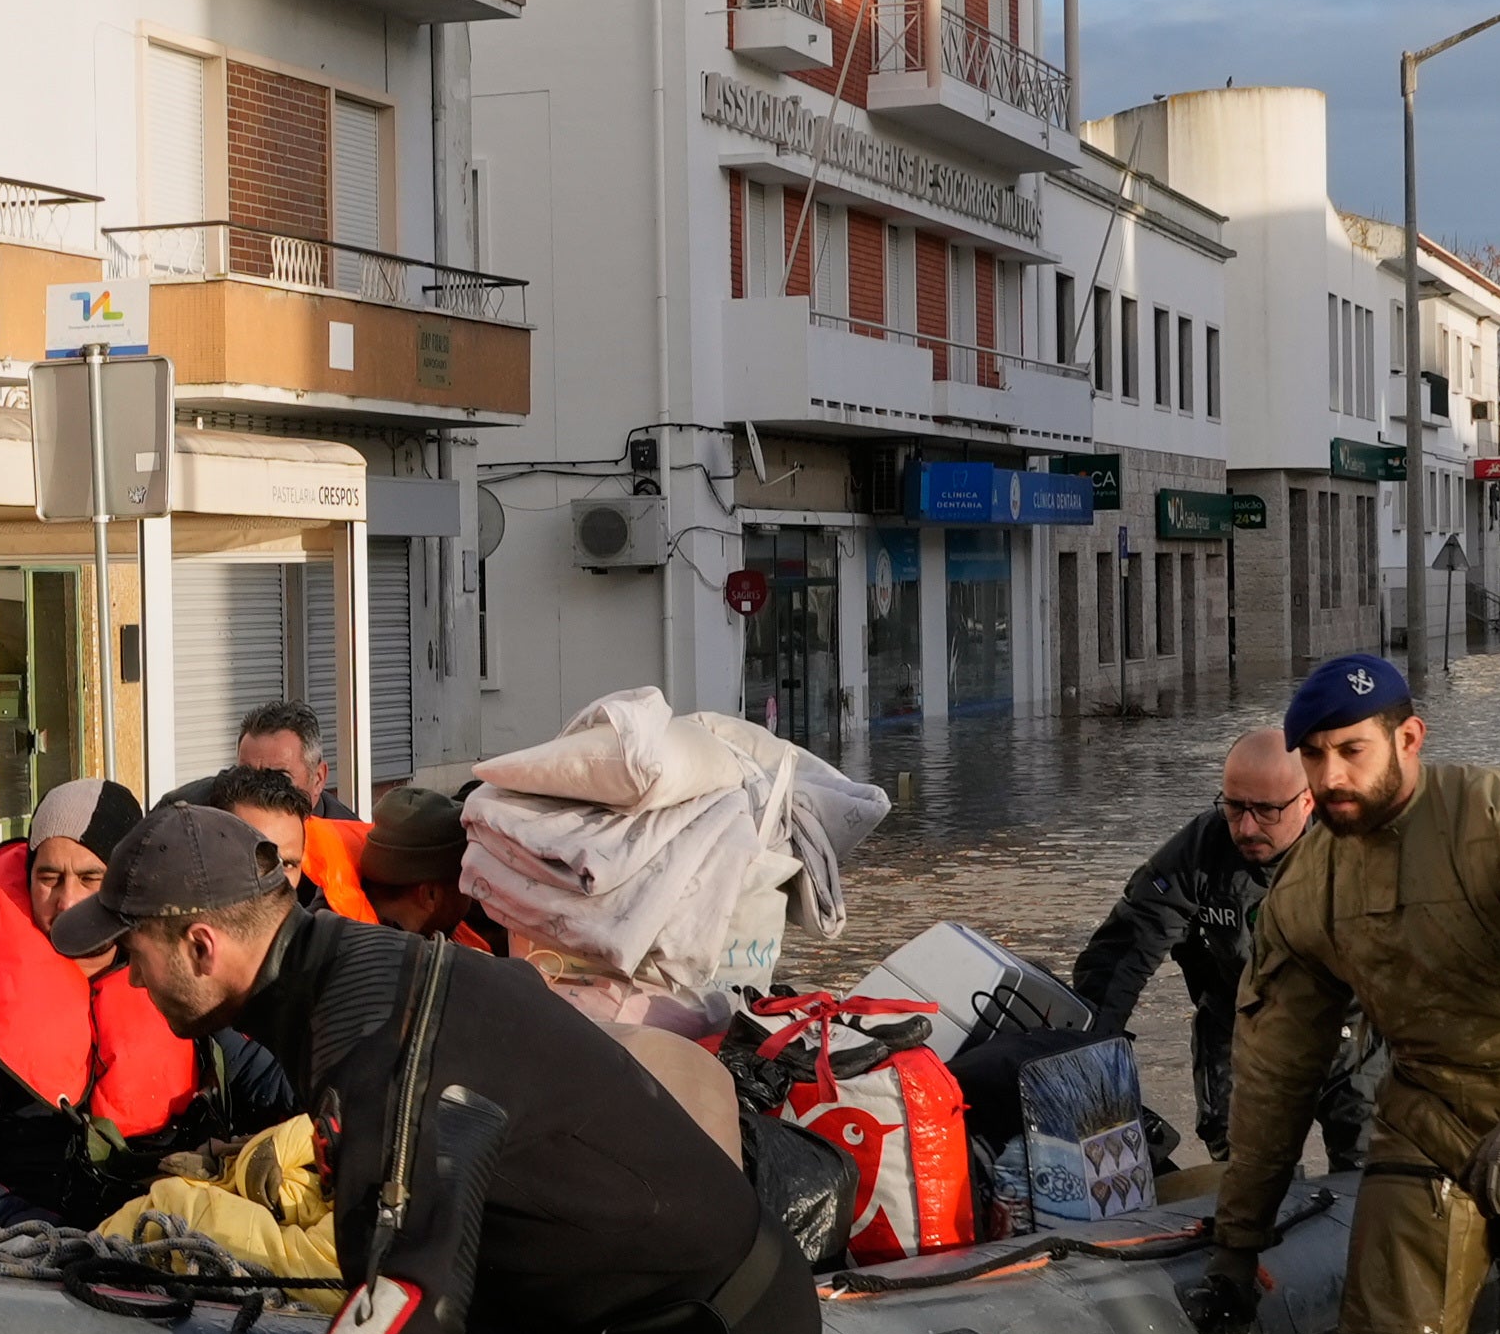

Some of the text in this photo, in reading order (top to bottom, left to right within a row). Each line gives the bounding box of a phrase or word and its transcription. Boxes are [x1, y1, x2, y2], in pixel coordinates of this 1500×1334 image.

[708, 72, 815, 153] ASSOCIAÇÃO
[917, 157, 935, 194] DE
[937, 167, 999, 222] SOCORROS
[1091, 470, 1117, 488] CA
[272, 485, 360, 507] PASTELARIA CRESPO'S
[941, 491, 979, 499] CLÍNICA
[1033, 488, 1083, 509] CLÍNICA DENTÁRIA
[936, 500, 983, 510] DENTÁRIA
[1234, 500, 1263, 511] Balcão
[1235, 513, 1251, 525] 24
[1198, 906, 1237, 928] GNR
